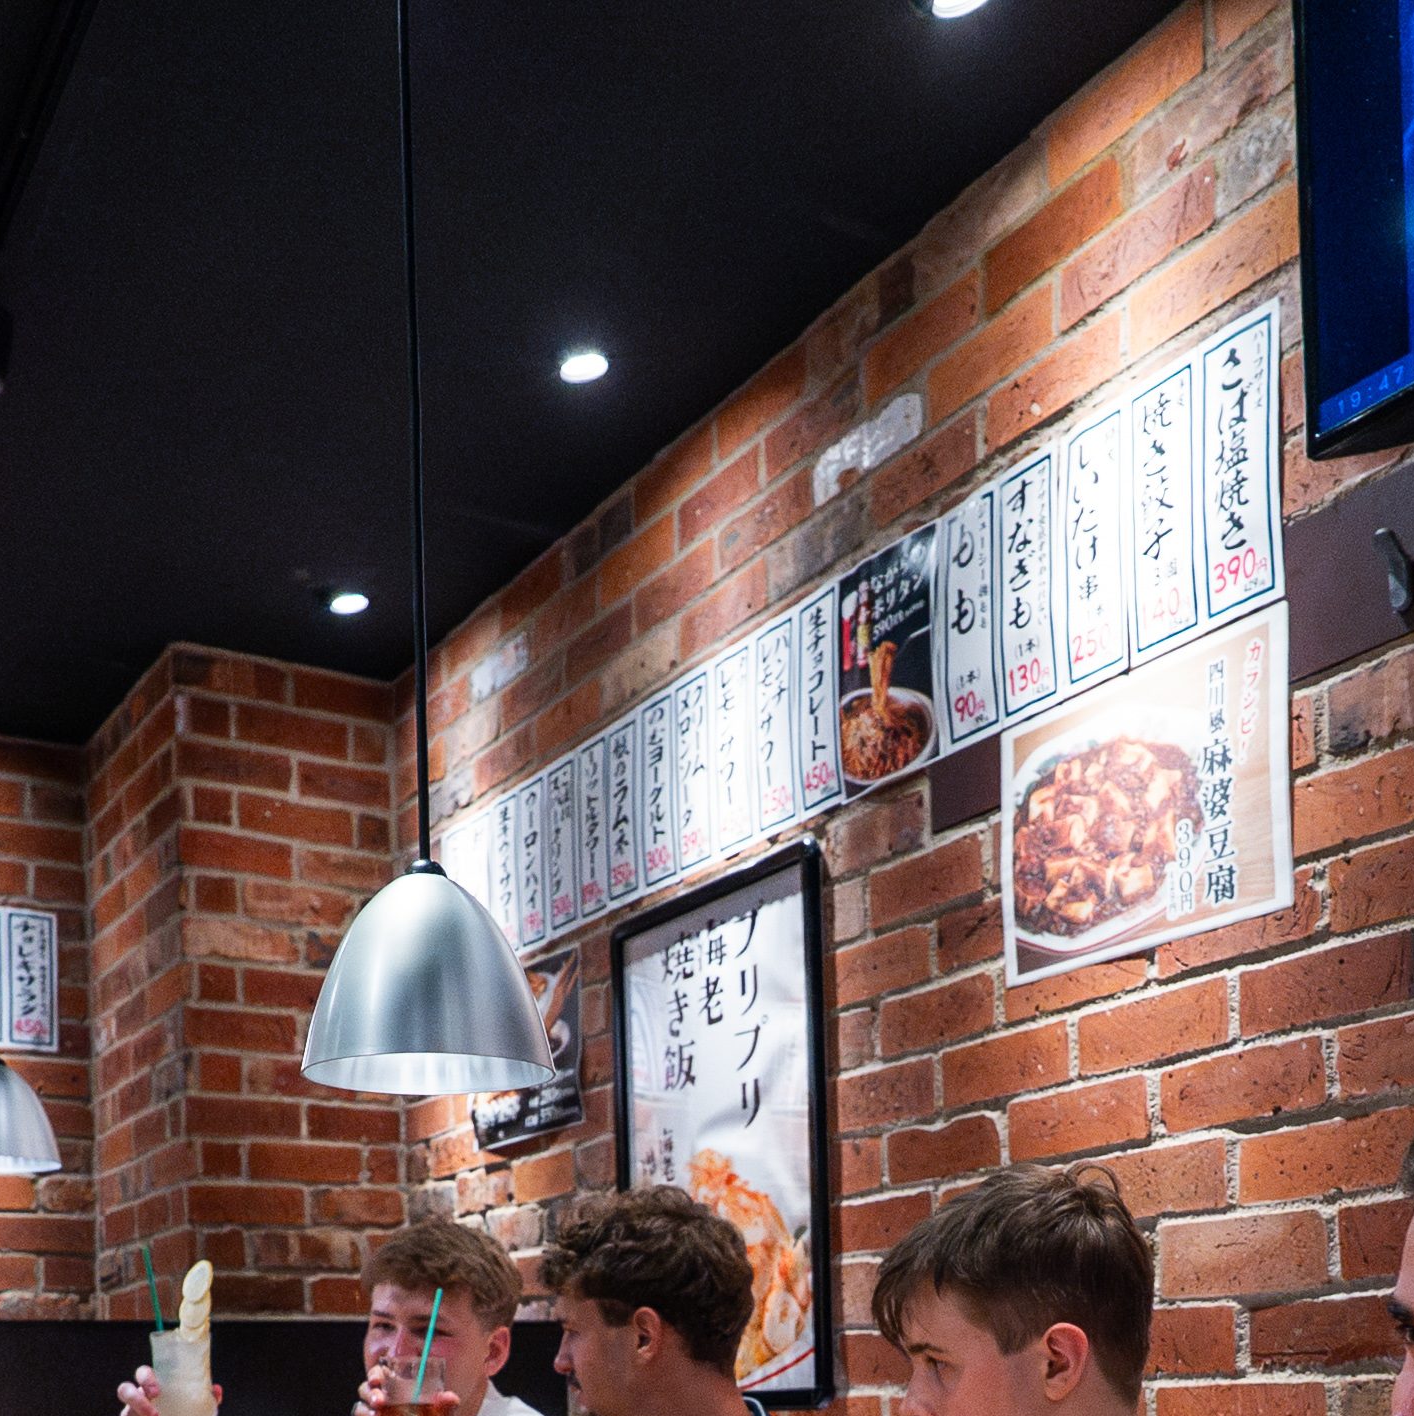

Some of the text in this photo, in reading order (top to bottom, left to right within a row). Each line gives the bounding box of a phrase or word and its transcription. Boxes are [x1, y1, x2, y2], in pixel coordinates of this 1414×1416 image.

[1214, 347, 1250, 551] さば塩焼き
[1338, 365, 1404, 415] 19:47
[1070, 443, 1100, 602] しいたけ串
[1139, 391, 1176, 562] 焼き餃子
[951, 523, 976, 635] もも
[1005, 478, 1034, 630] すなぎも
[1213, 547, 1268, 594] 390円
[759, 641, 775, 787] レモンサワー
[807, 604, 828, 761] 生チョコレート
[953, 690, 987, 722] 90円
[1008, 658, 1050, 697] 130円
[1178, 822, 1193, 912] 390円
[662, 932, 696, 1092] 焼き飯
